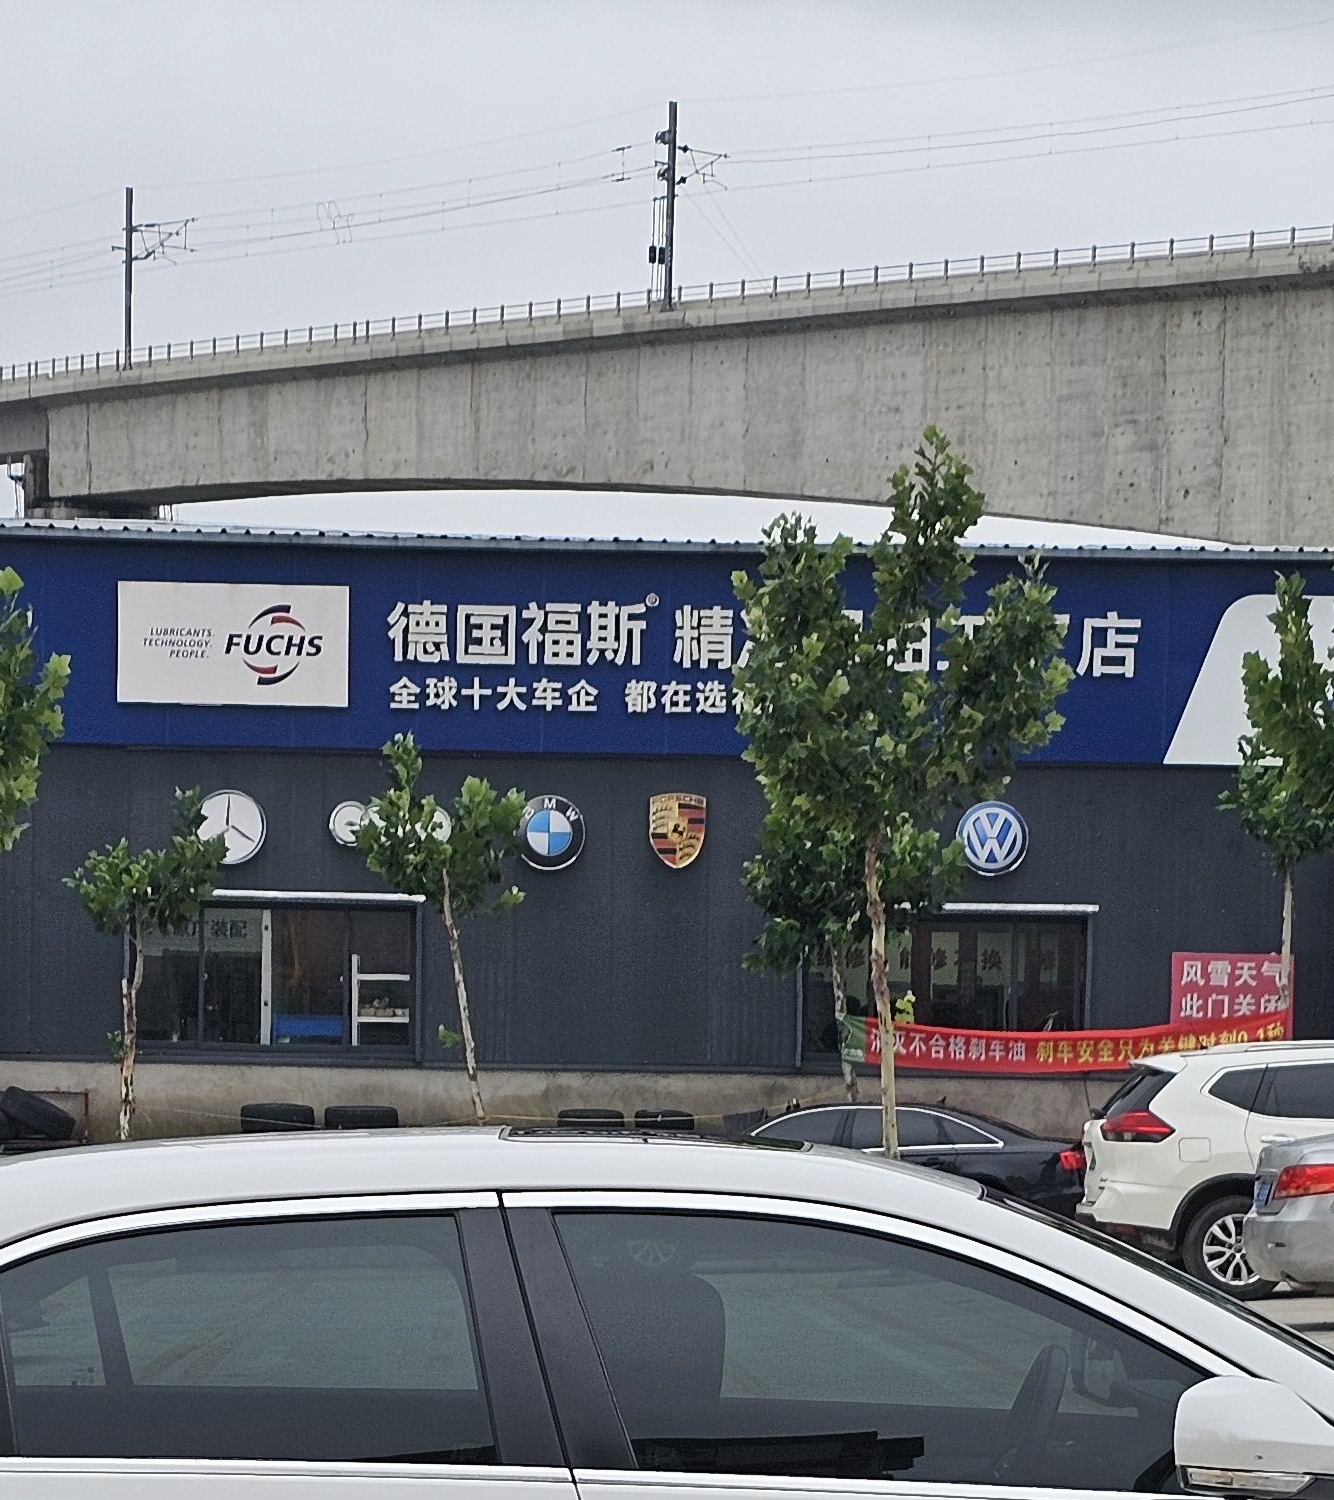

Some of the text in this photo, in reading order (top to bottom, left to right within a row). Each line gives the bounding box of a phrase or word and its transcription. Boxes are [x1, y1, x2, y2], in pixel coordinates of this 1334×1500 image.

[224, 633, 323, 657] FUCHS
[387, 600, 647, 666] 德国福斯
[389, 676, 599, 713] 全球十大车企
[1181, 960, 1283, 988] 风雪天气
